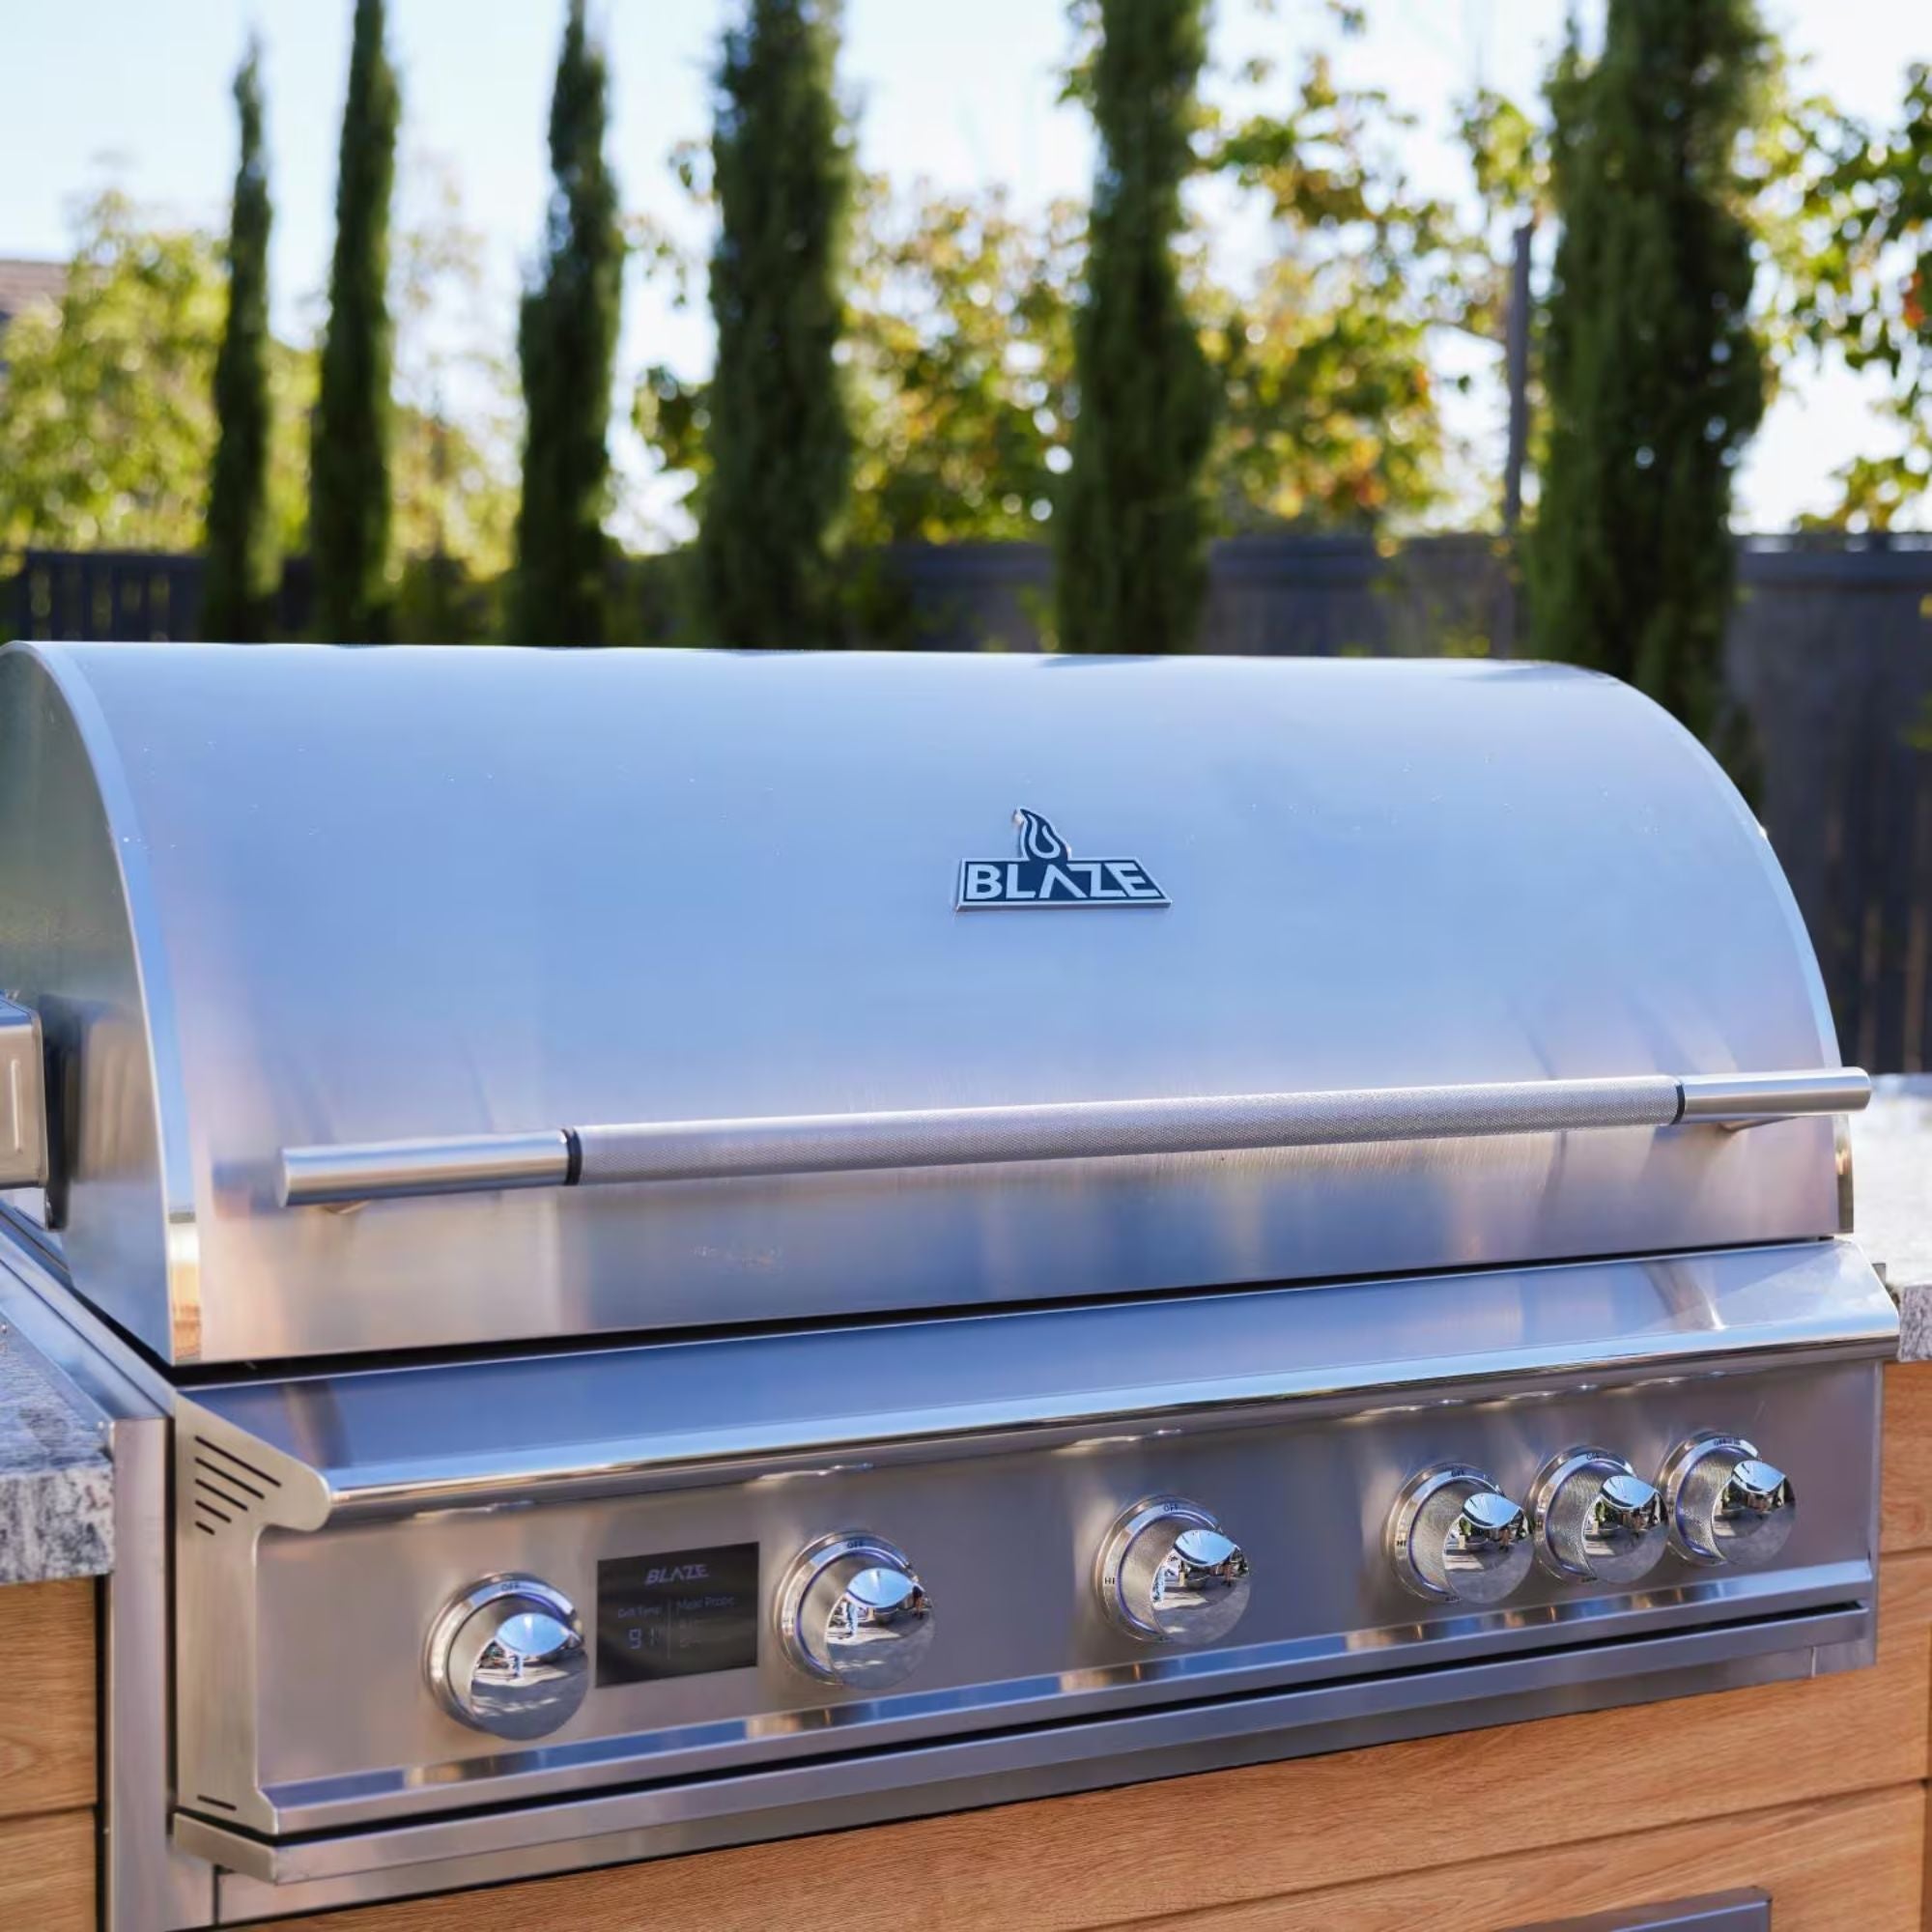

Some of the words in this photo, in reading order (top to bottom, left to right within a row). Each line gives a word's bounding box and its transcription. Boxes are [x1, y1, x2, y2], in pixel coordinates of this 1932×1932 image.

[966, 864, 1161, 899] BLAZE
[645, 1564, 709, 1585] BLAZE
[501, 1582, 519, 1591] OFF
